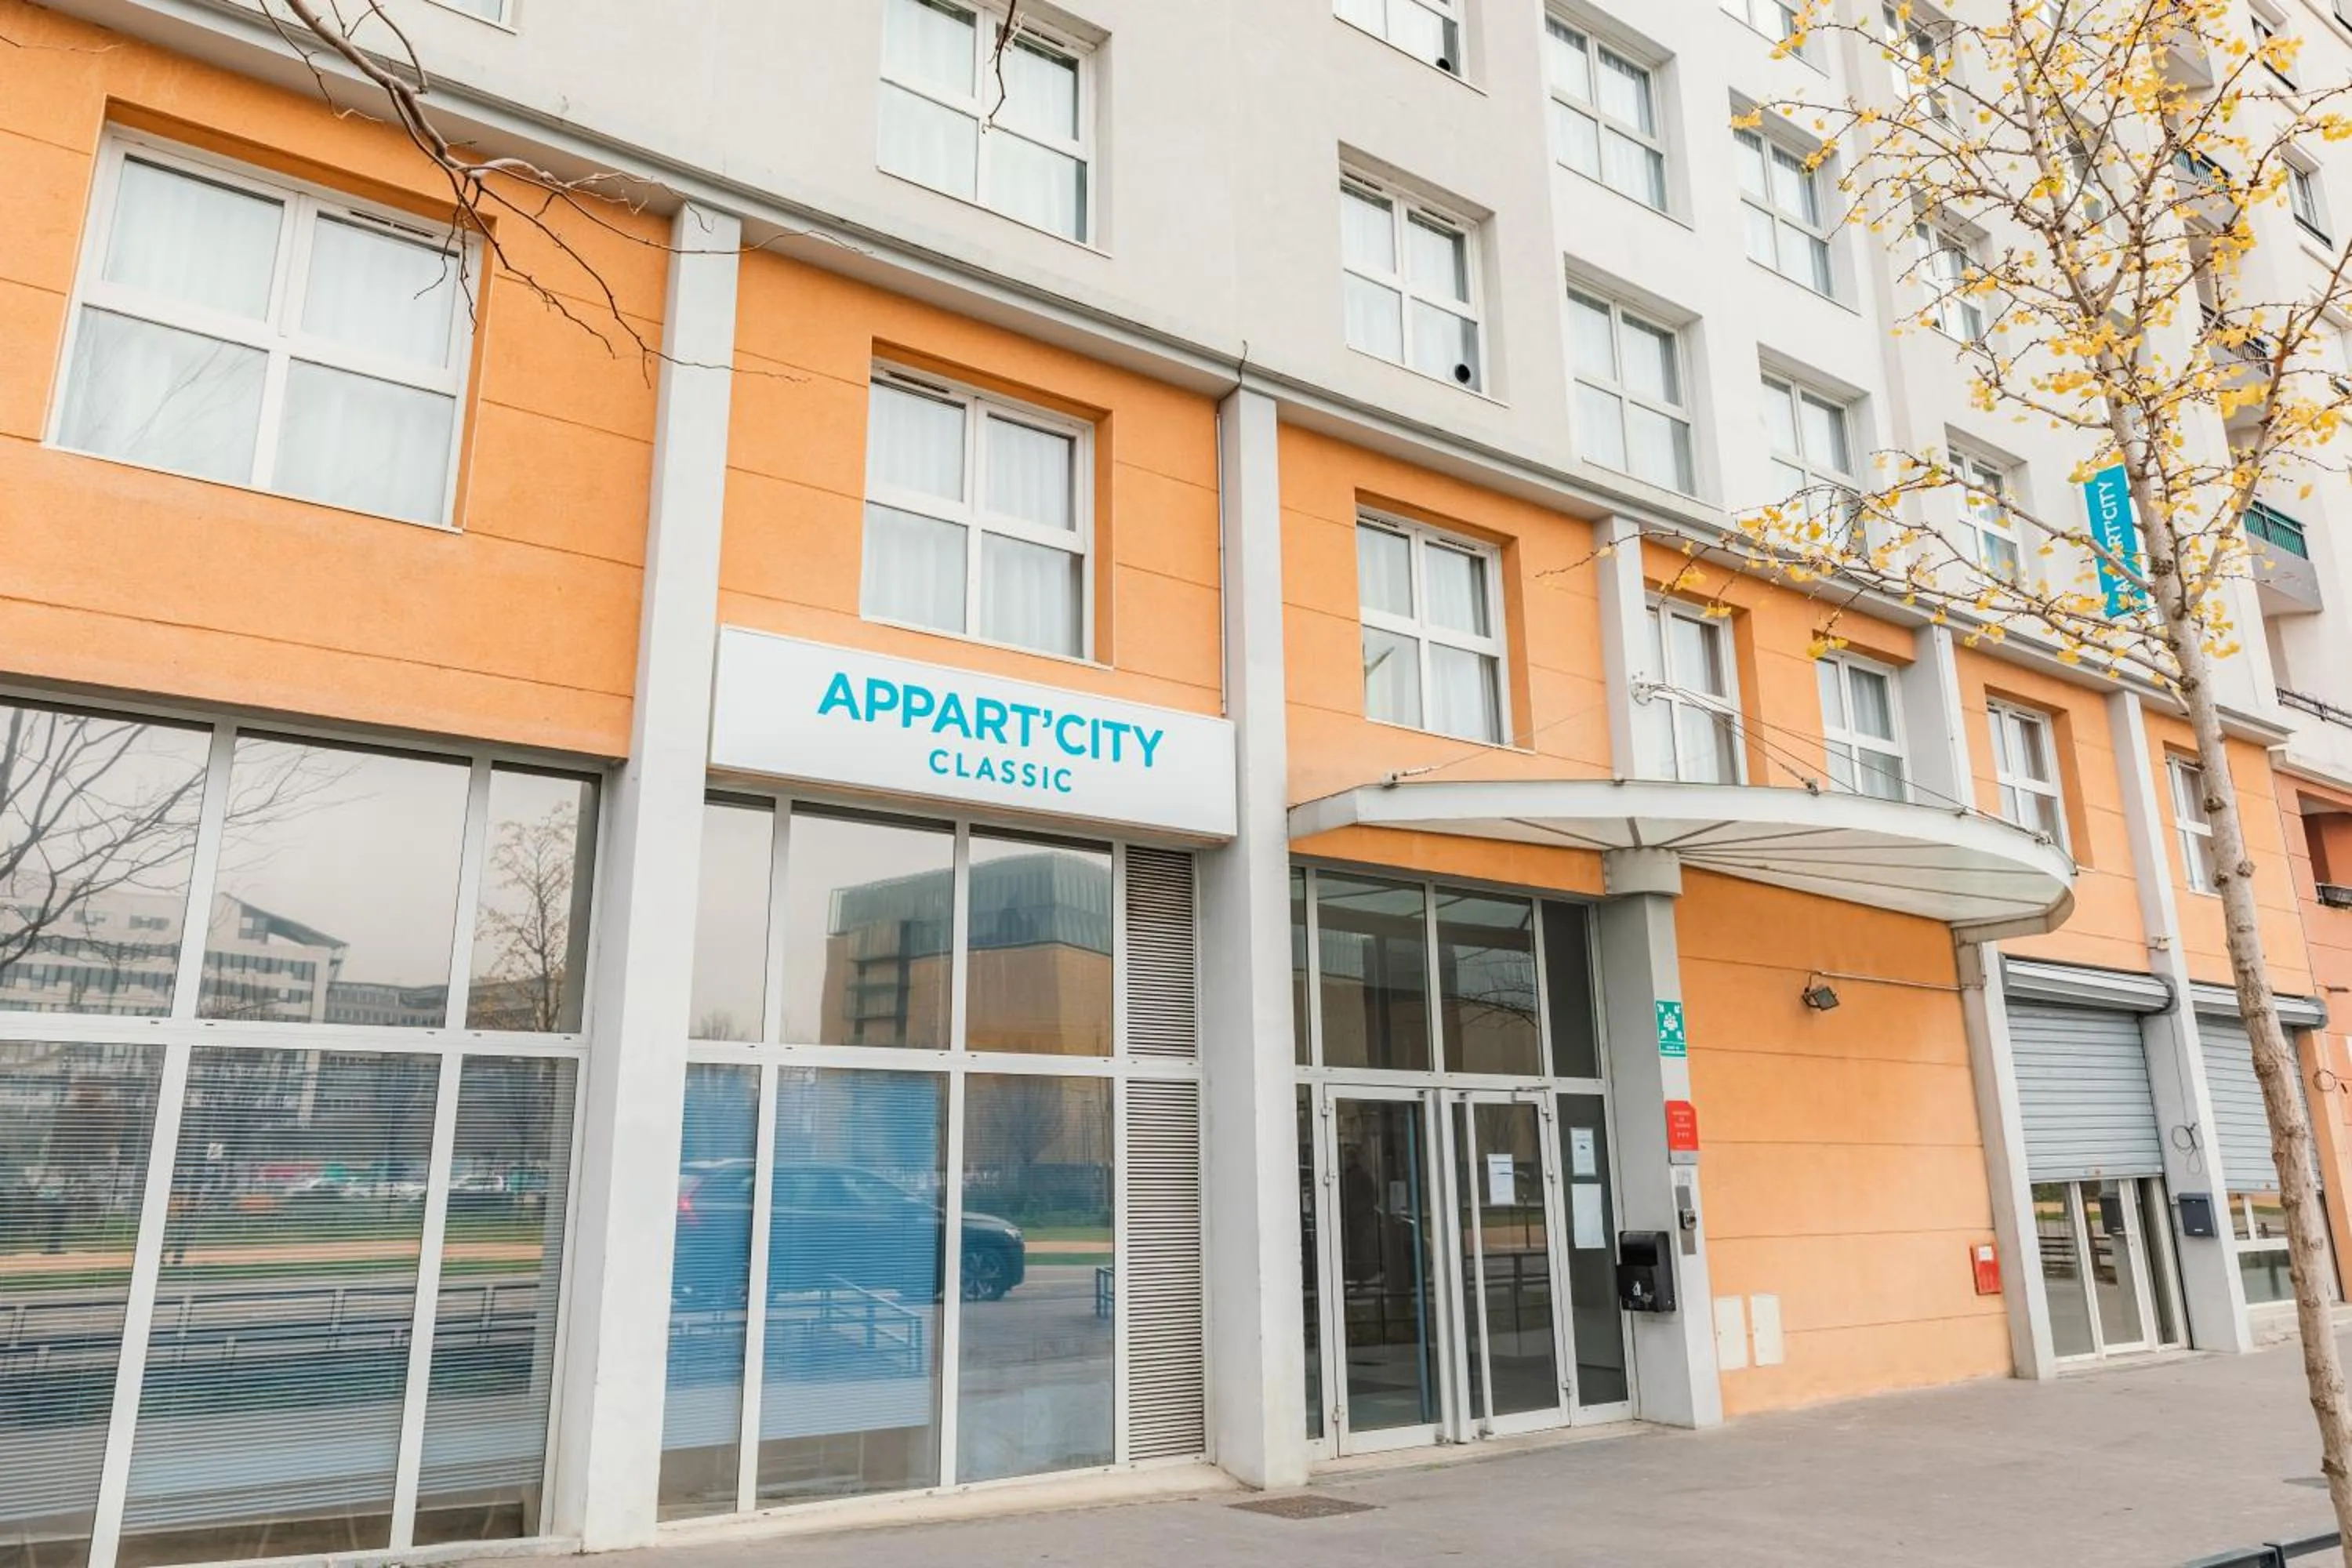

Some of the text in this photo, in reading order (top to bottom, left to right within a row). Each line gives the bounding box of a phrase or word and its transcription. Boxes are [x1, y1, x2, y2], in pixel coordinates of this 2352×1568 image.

[2097, 481, 2131, 593] ART'CITY
[816, 671, 1165, 769] APPART'CITY
[927, 747, 1073, 793] CLASSIC
